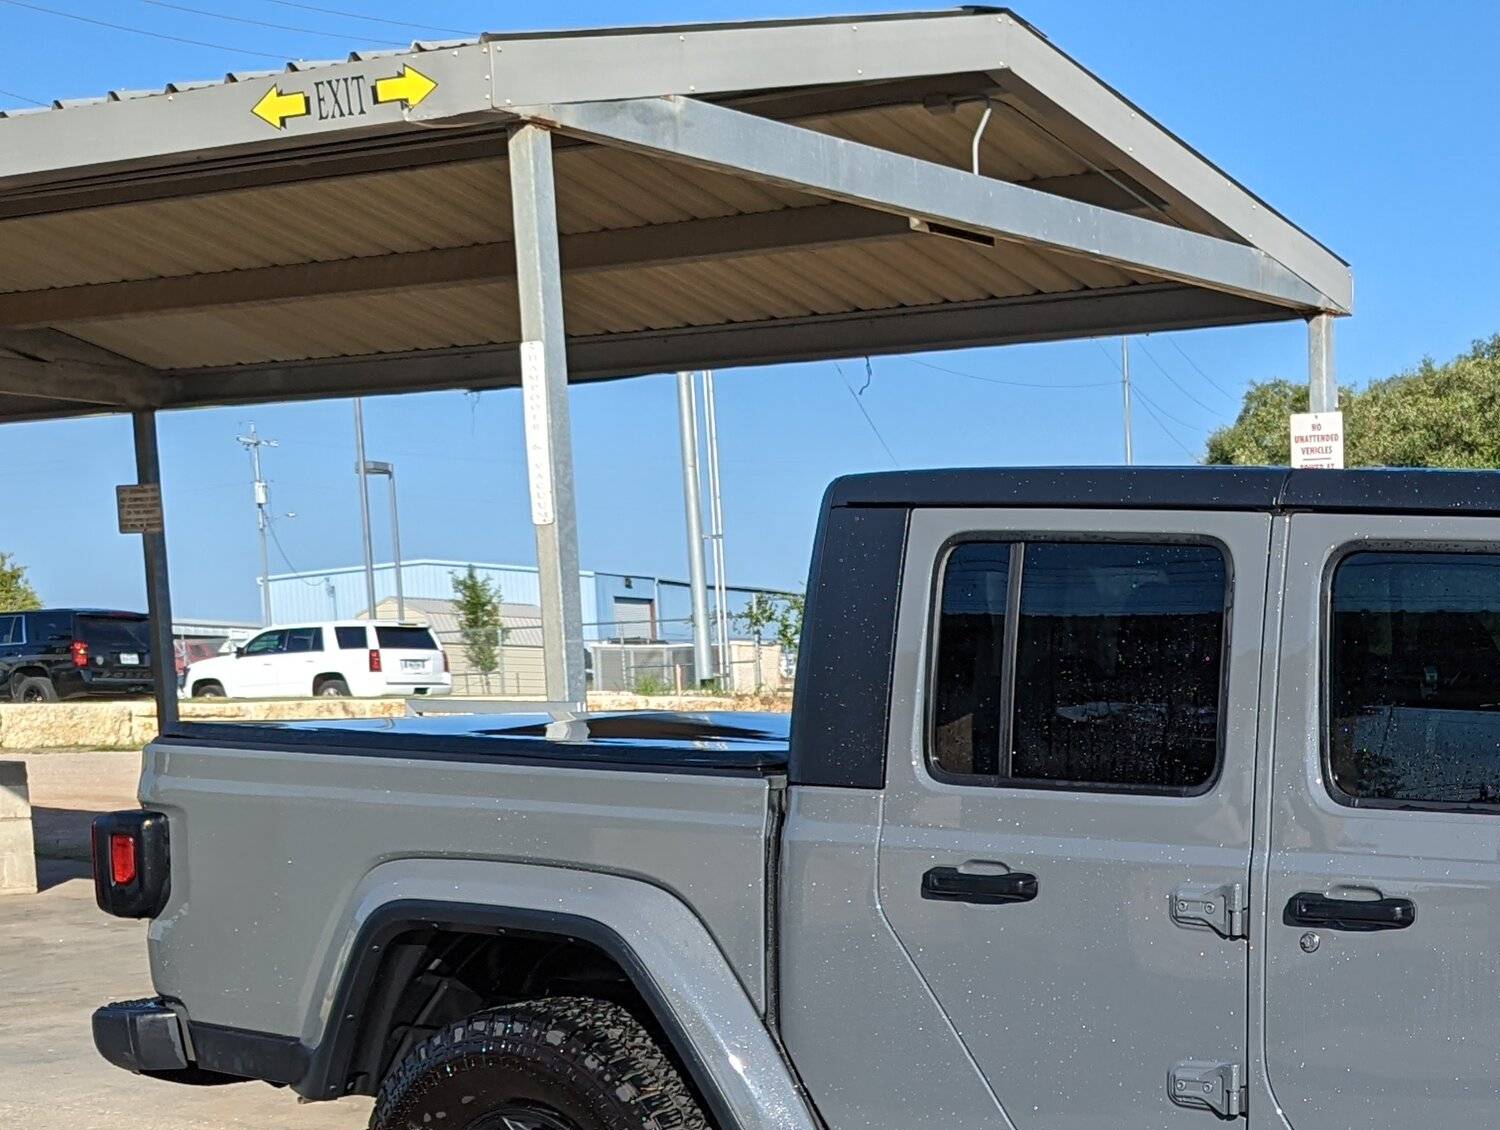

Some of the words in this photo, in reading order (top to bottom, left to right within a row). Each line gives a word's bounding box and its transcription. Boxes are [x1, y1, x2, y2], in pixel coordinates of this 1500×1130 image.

[314, 75, 367, 121] EXIT
[1311, 423, 1322, 432] NO
[1294, 433, 1340, 444] UNATTENDED
[1301, 446, 1333, 455] VEHICLES
